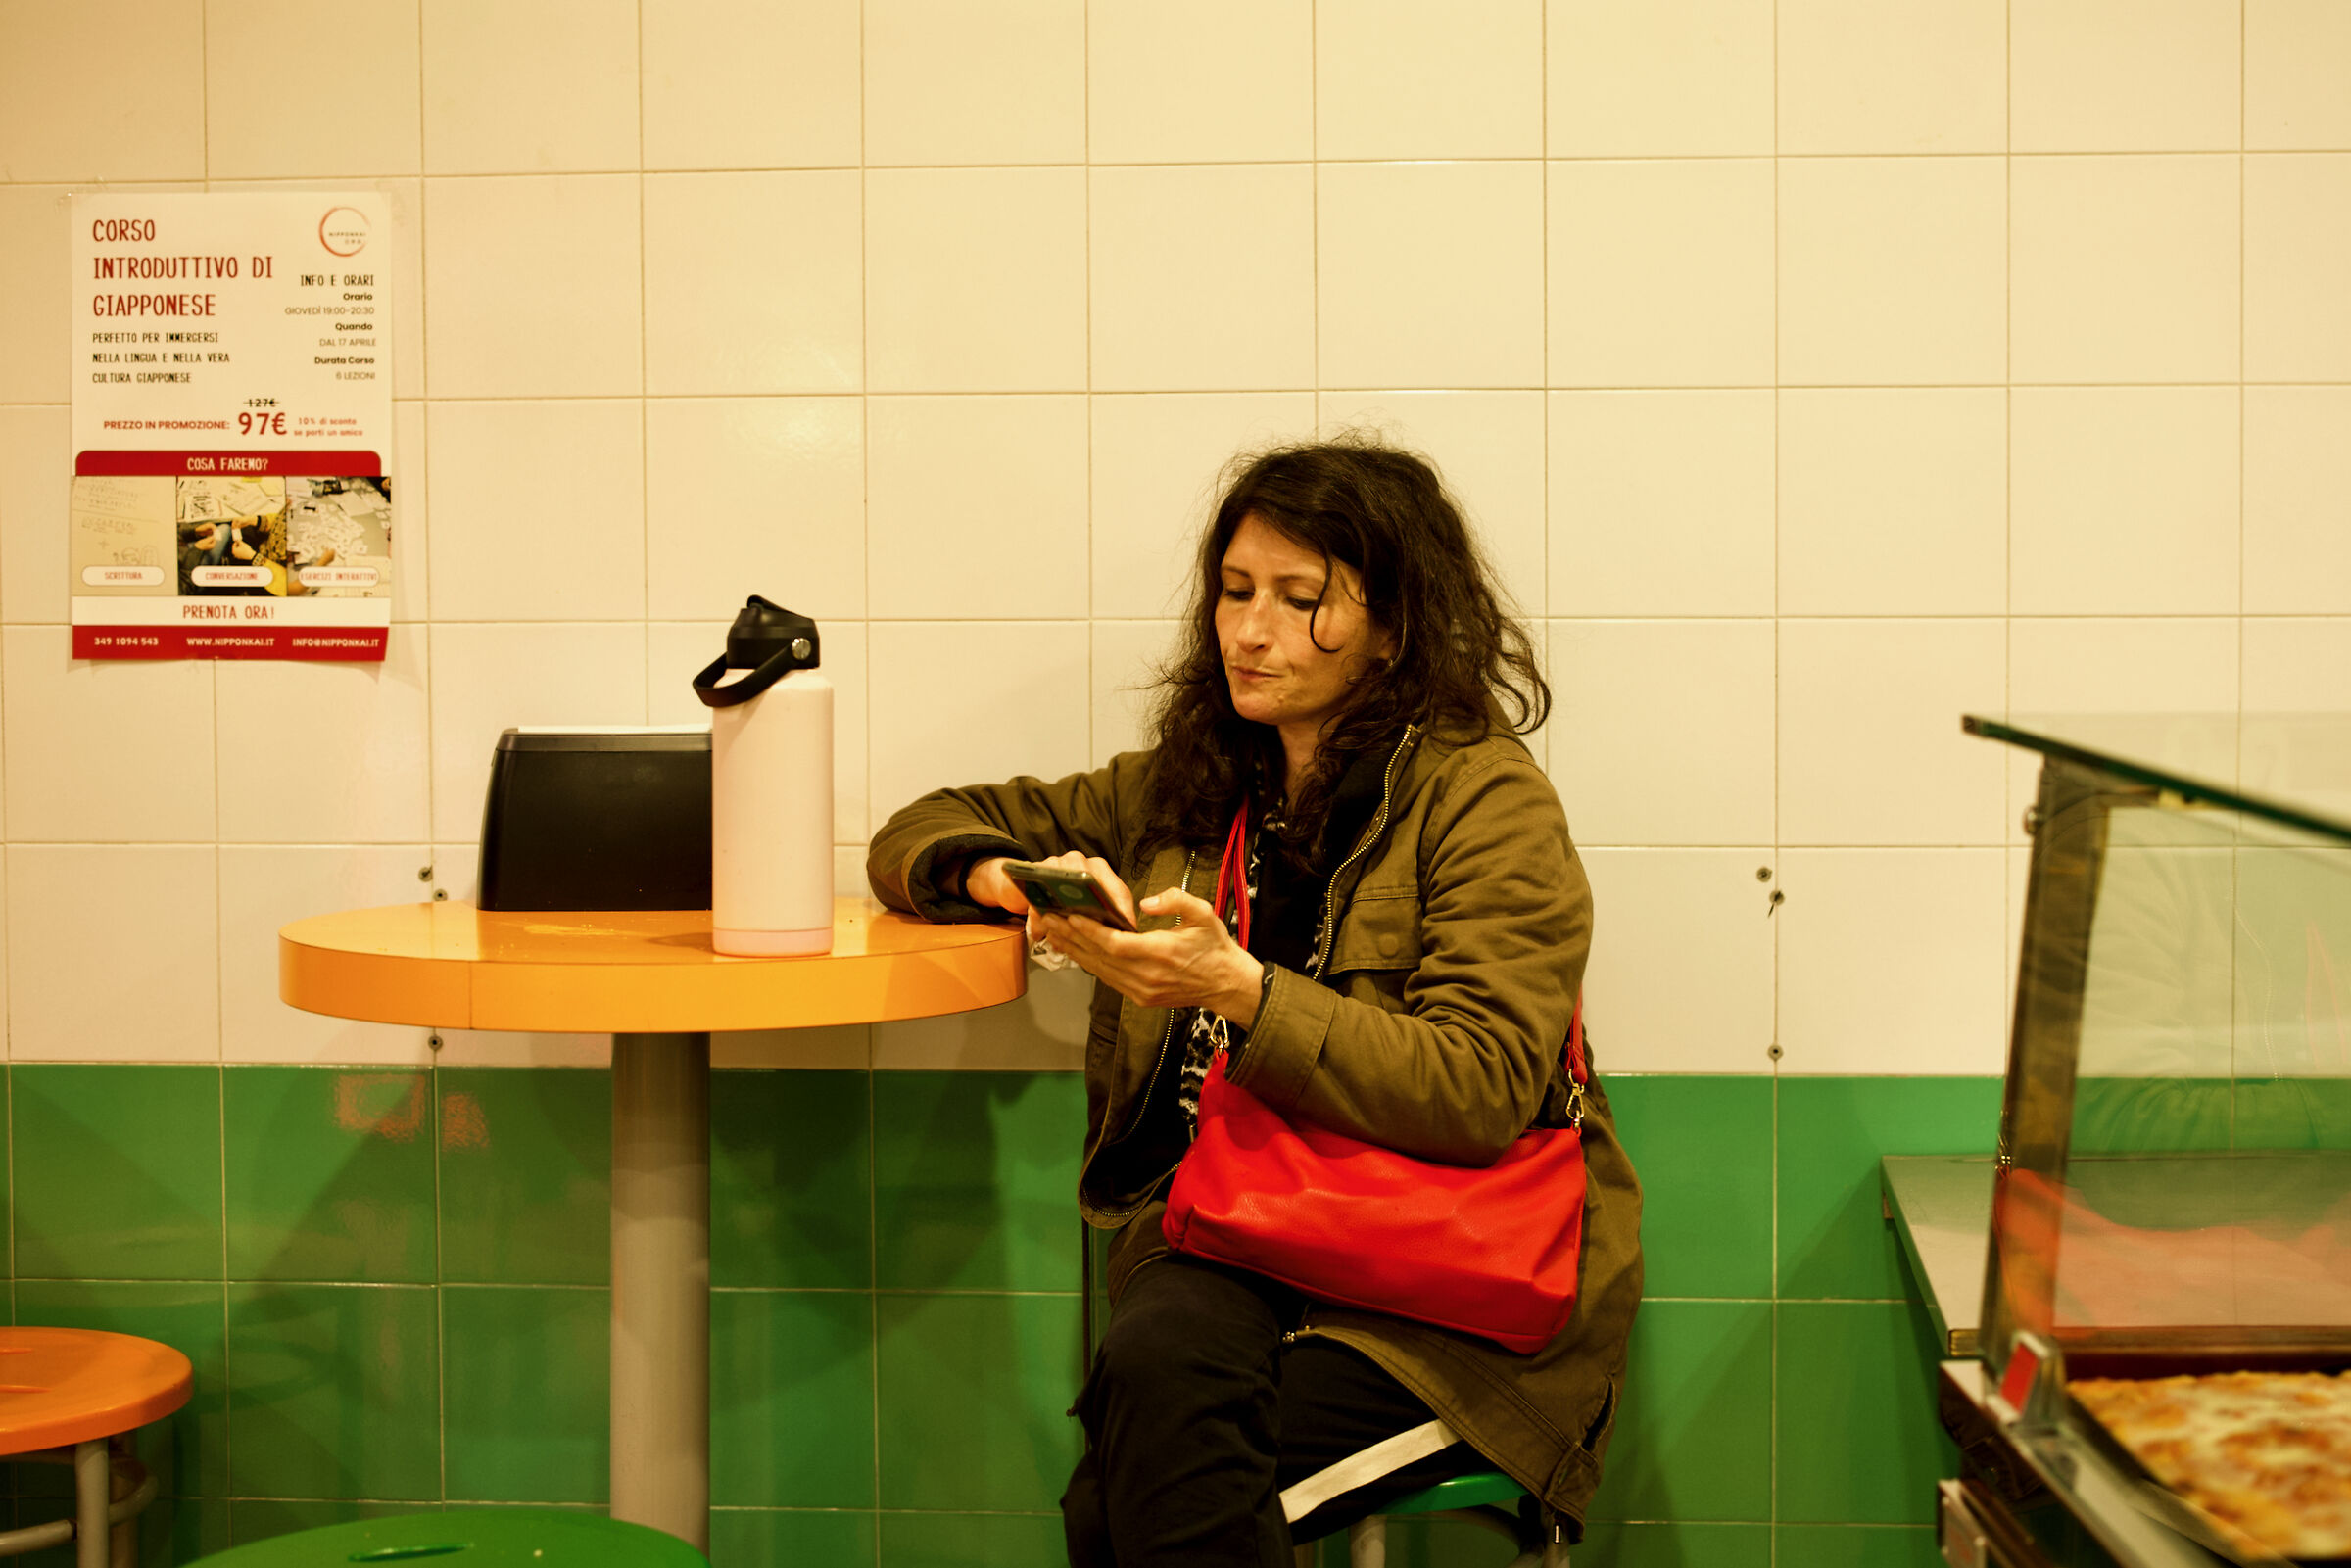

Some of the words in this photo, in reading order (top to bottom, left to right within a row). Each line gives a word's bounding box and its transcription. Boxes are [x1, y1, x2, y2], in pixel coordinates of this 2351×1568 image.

[93, 219, 156, 242] CORSO
[93, 257, 238, 279] INTRODUTTIVO
[252, 256, 273, 278] DI
[300, 275, 324, 286] INFO
[330, 275, 336, 286] E
[344, 275, 374, 286] ORARI
[93, 295, 216, 316] GIAPPONESE
[284, 306, 321, 314] GIOVEDÌ
[335, 322, 373, 331] Quando
[92, 332, 137, 343] PERFETTO
[142, 332, 160, 343] PER
[165, 332, 218, 343] IMMERGERSI
[92, 353, 120, 363] NELLA
[124, 353, 157, 363] LINGUA
[163, 353, 168, 362] E
[173, 353, 202, 362] NELLA
[207, 353, 230, 362] VERA
[92, 373, 131, 383] CULTURA
[136, 373, 191, 383] GIAPPONESE
[344, 371, 376, 380] LEZIONI
[248, 399, 276, 407] 127€
[104, 421, 143, 430] PREZZO
[158, 421, 230, 430] PROMOZIONE:
[238, 412, 287, 435] 97€
[187, 457, 215, 470] COSA
[220, 457, 268, 470] FAREMO?
[205, 572, 258, 581] CONVERSAZIONE
[183, 605, 237, 619] PRENOTA
[245, 605, 274, 619] ORA!
[94, 637, 112, 645] 349
[116, 637, 137, 645] 1094
[140, 637, 159, 645] 543
[186, 638, 274, 646] WWW.NIPPONKAI.IT
[292, 639, 379, 647] INFO@NIPPONKAI.IT
